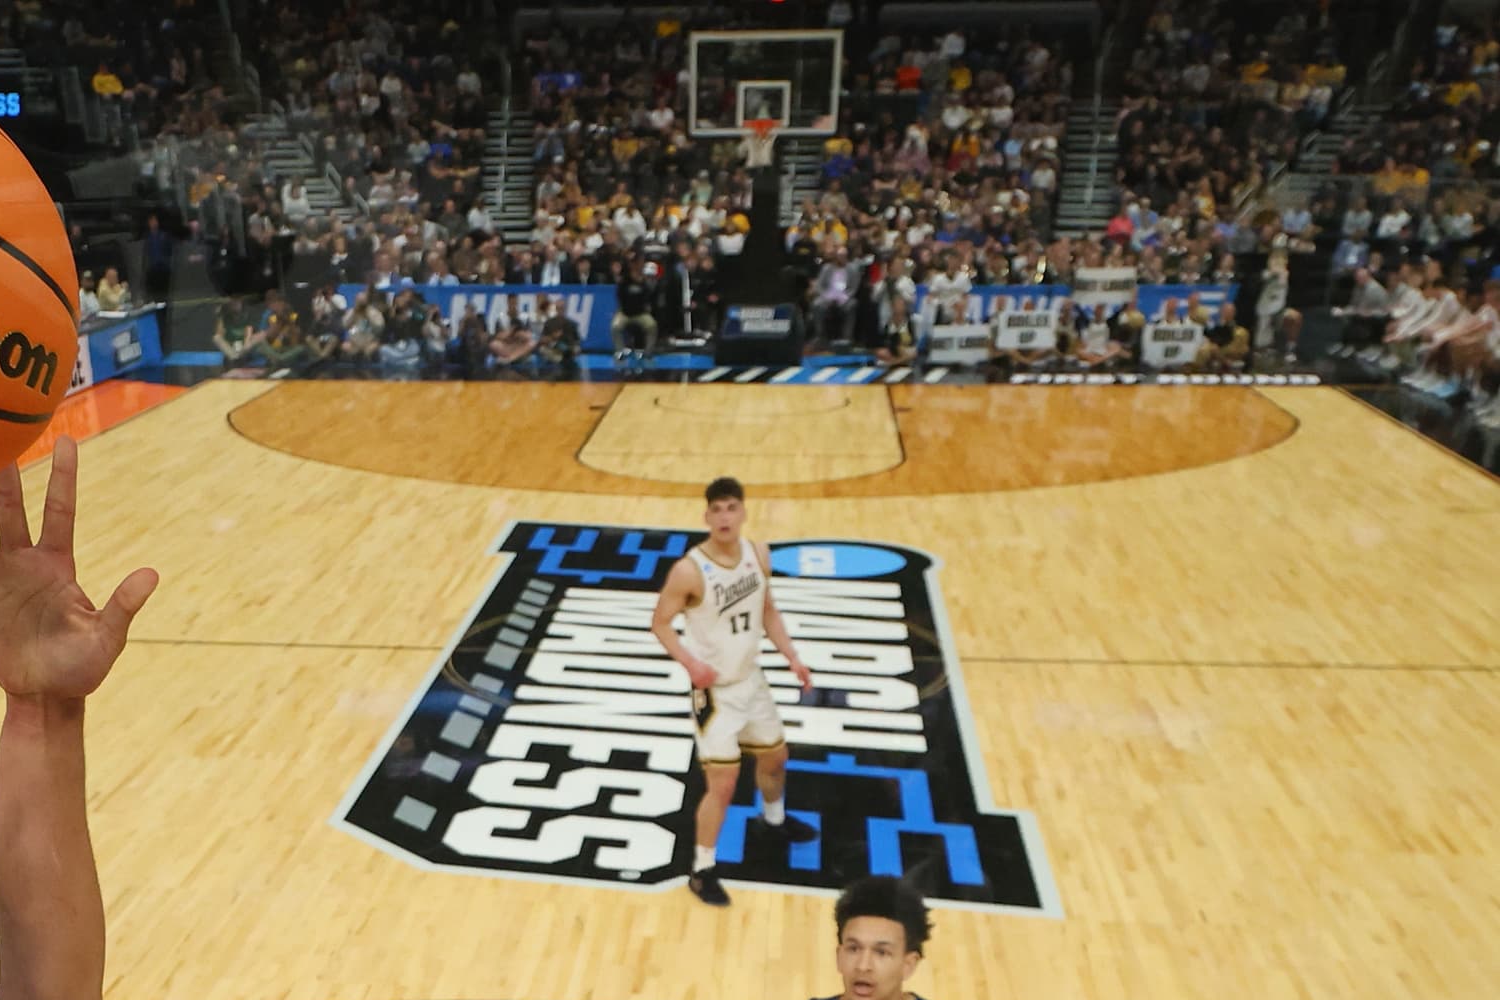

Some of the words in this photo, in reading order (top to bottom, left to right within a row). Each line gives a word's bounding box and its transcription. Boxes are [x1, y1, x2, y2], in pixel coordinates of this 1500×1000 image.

[713, 571, 761, 613] Purdue
[730, 612, 751, 634] 17
[442, 587, 696, 873] MADNESS
